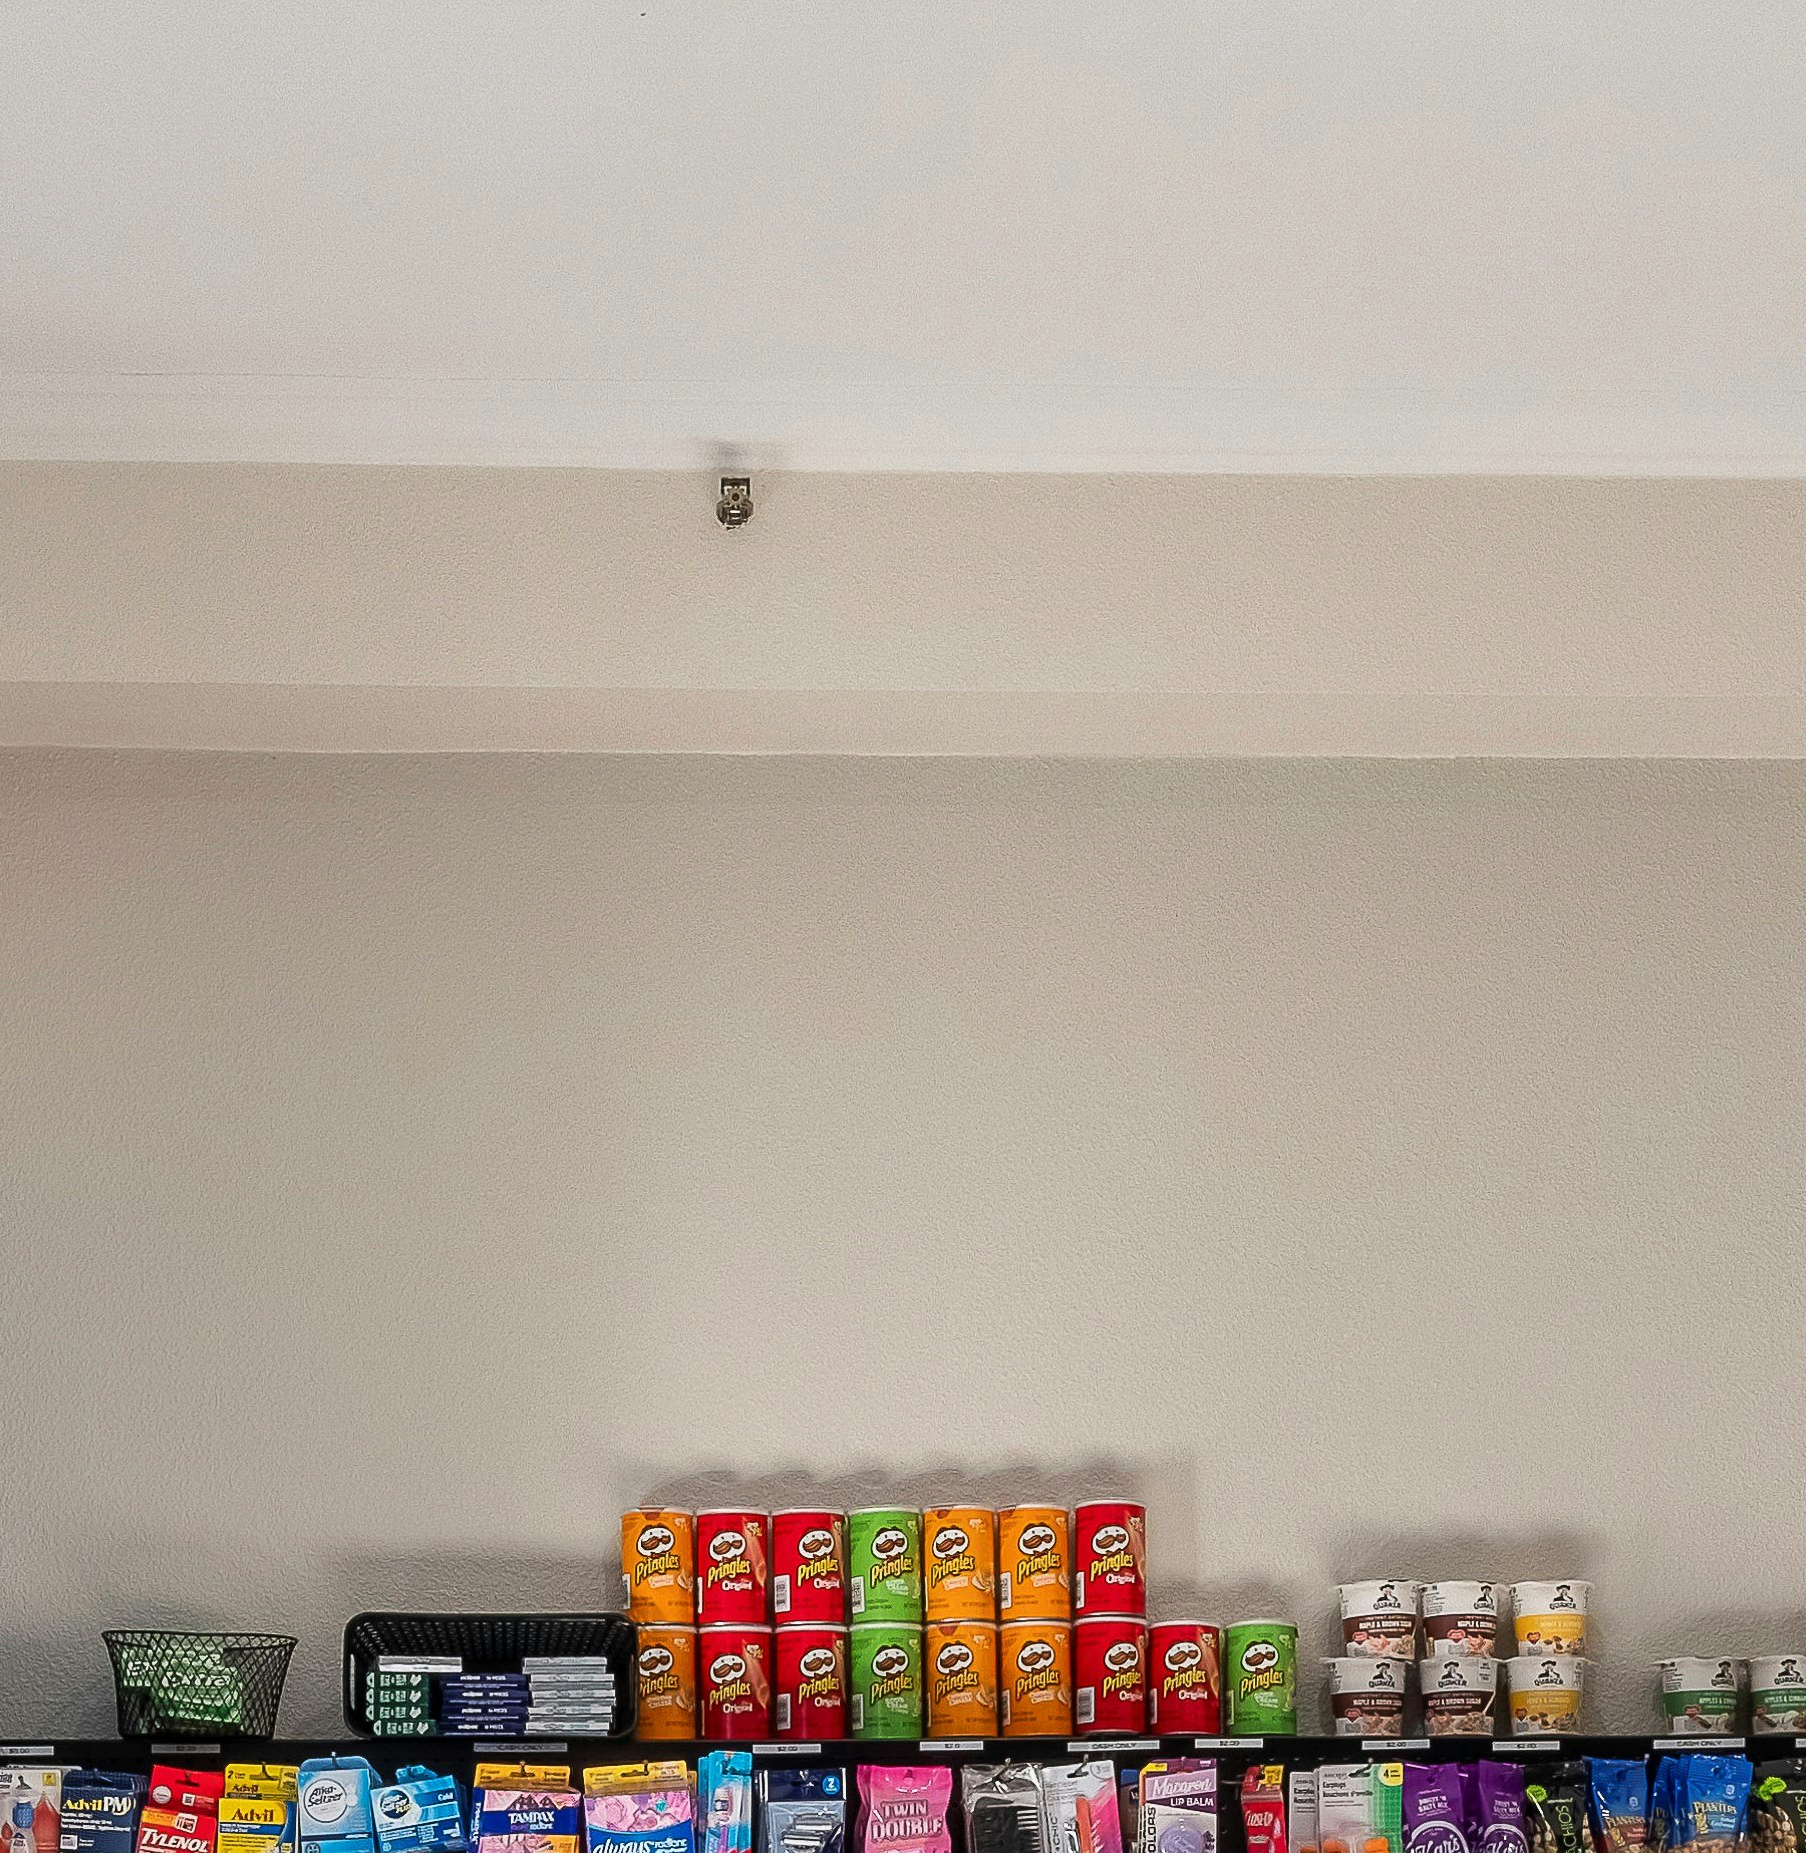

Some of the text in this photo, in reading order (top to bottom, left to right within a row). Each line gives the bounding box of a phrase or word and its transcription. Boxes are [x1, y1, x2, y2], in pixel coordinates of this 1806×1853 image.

[707, 1558, 752, 1586] Pringles
[797, 1557, 839, 1587] Pringles
[870, 1558, 913, 1587] Pringles
[1383, 1769, 1389, 1779] 4
[881, 1800, 927, 1818] TWIN
[1170, 1797, 1214, 1807] LIP BALM
[508, 1811, 554, 1824] TAMPAX
[872, 1817, 943, 1841] DOUBLE
[141, 1828, 209, 1852] TYLENOL
